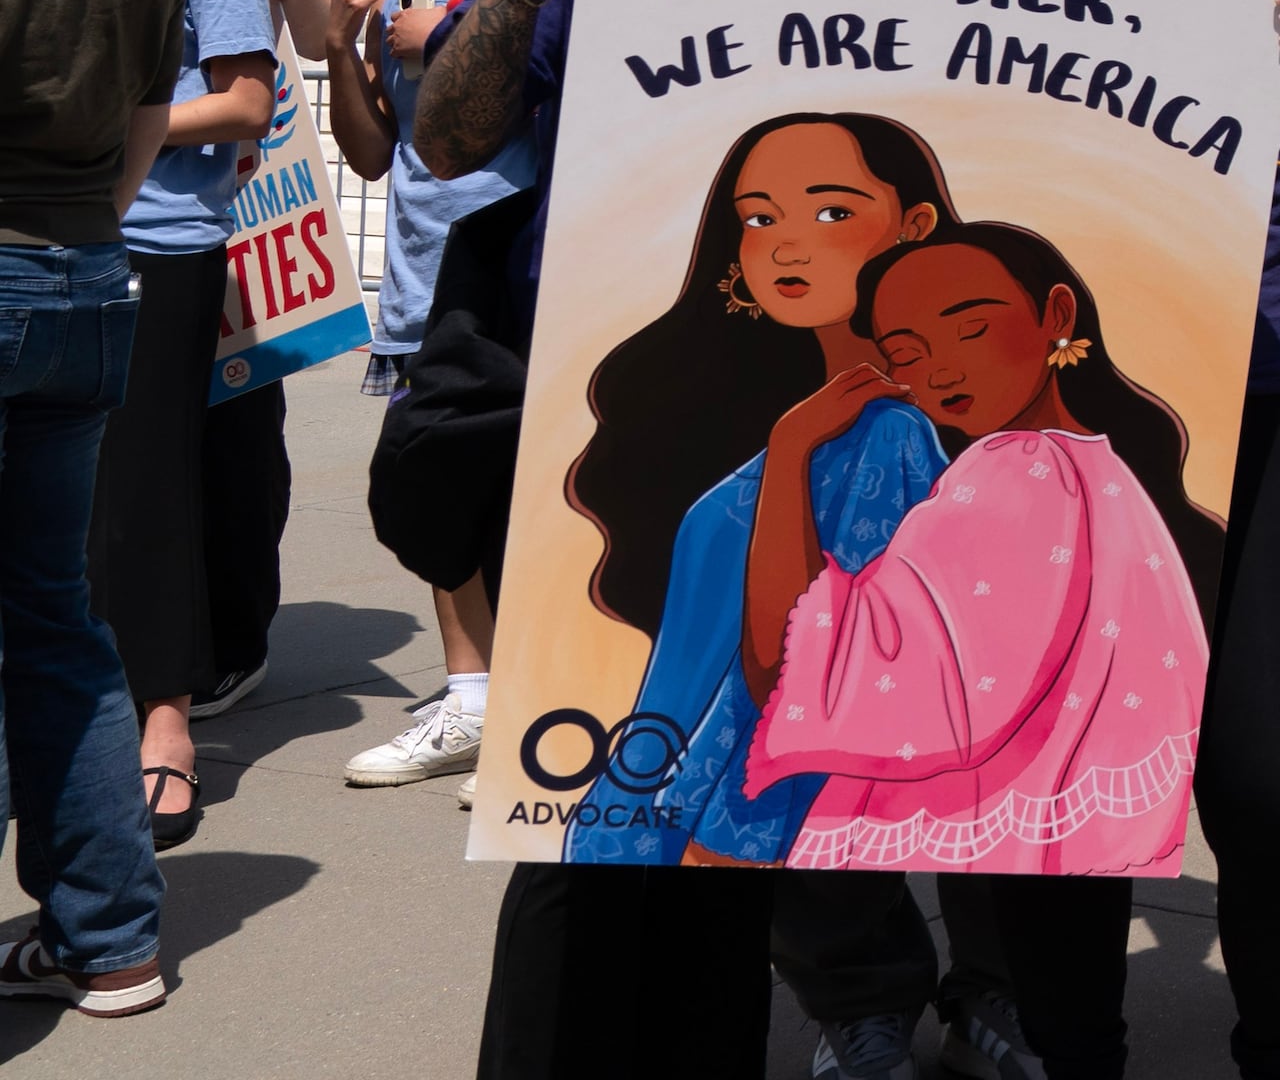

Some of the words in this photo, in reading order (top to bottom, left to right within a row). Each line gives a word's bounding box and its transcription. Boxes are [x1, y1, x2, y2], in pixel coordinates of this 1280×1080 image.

[624, 23, 753, 98] WE
[777, 12, 914, 71] ARE
[945, 21, 1243, 176] AMERICA
[220, 208, 336, 338] TIES
[506, 801, 683, 829] ADVOCATE
